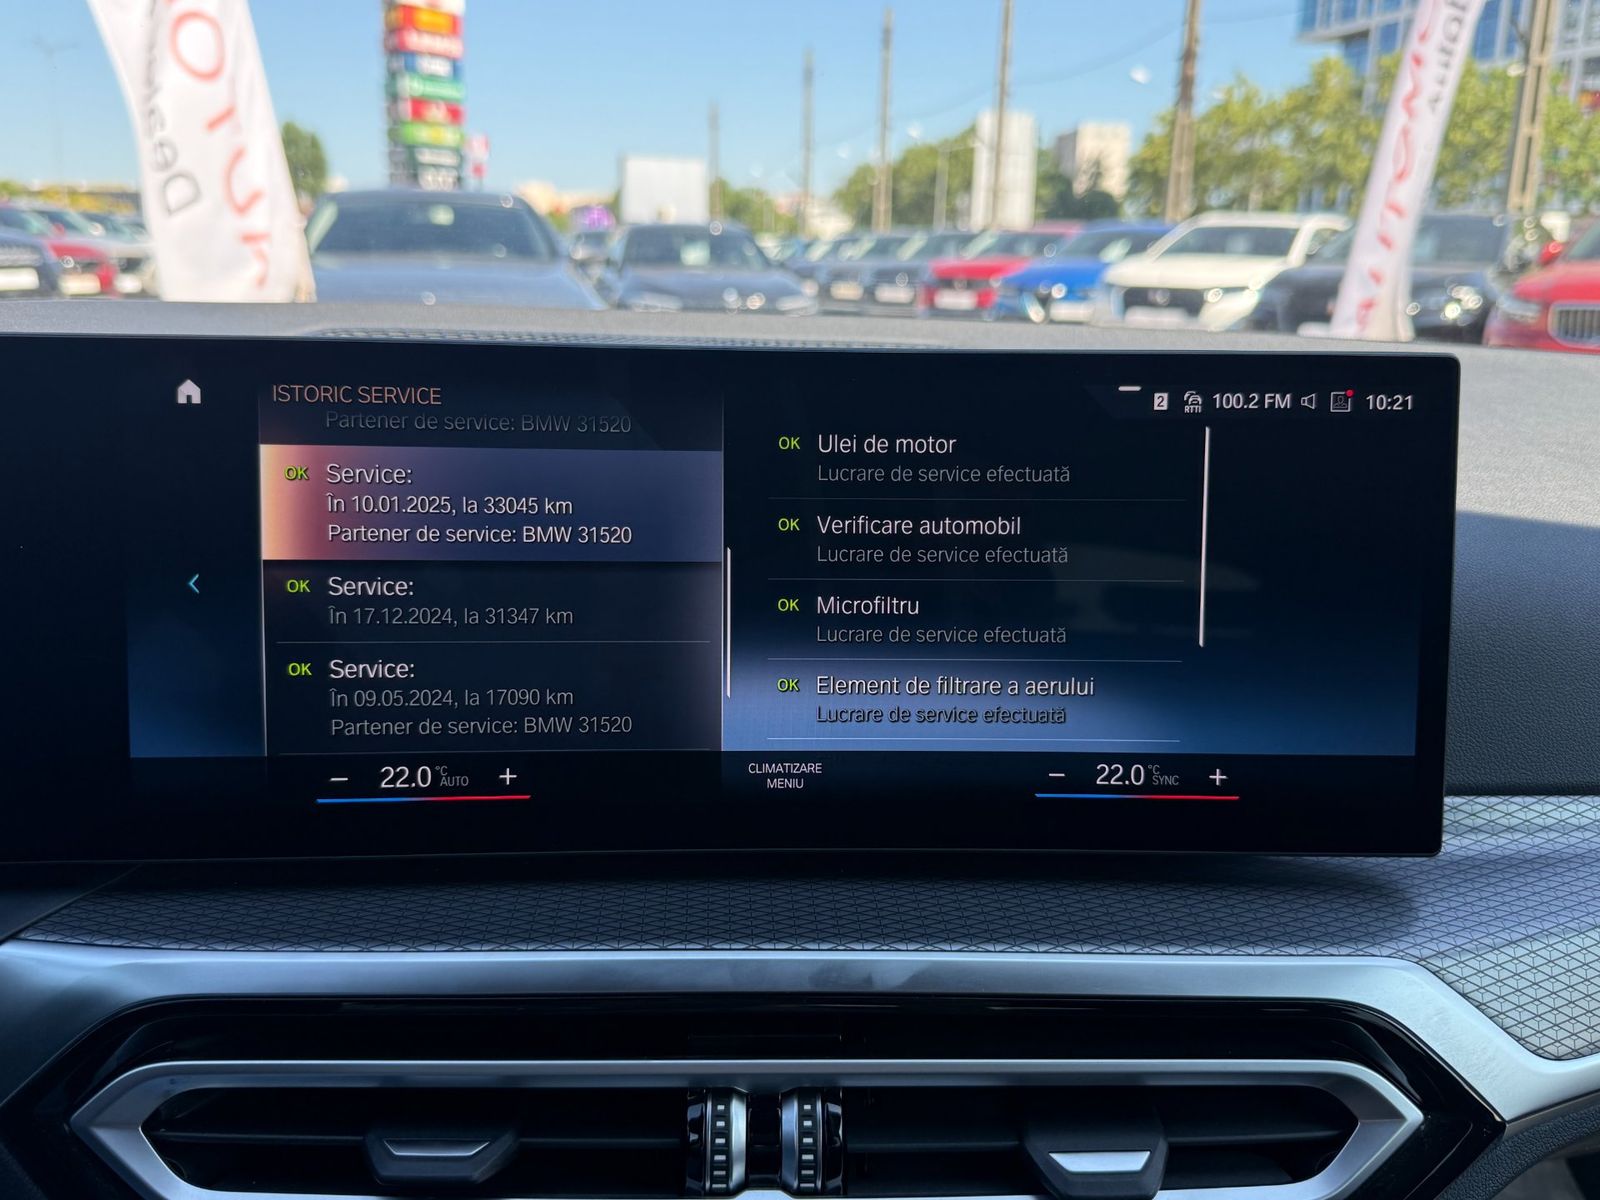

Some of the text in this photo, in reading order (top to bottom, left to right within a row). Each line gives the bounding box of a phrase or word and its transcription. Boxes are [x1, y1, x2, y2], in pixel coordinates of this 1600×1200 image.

[273, 385, 441, 405] ISTORIC SERVICE
[1157, 395, 1165, 408] 2
[1213, 393, 1291, 409] 100.2 FM
[1366, 395, 1413, 410] 10:21
[325, 410, 632, 433] Partener de service: BMW 31520
[778, 436, 800, 450] OK
[817, 434, 957, 454] Ulei de motor
[284, 466, 308, 480] OK
[327, 463, 413, 484] Service:
[817, 465, 1070, 483] Lucrare de service efectuată
[327, 493, 573, 516] În 10.01.2025, la 33045 km
[328, 524, 632, 544] Partener de service: BMW 31520
[778, 518, 800, 531] OK
[817, 516, 1021, 535] Verificare automobil
[817, 546, 1069, 564] Lucrare de service efectuată
[286, 579, 310, 594] OK
[328, 577, 414, 598] Service:
[777, 599, 799, 612] OK
[817, 596, 919, 616] Microfiltru
[329, 605, 574, 627] În 17.12.2024, la 31347 km
[816, 626, 1067, 645] Lucrare de service efectuată
[288, 662, 312, 676] OK
[329, 659, 415, 680] Service:
[777, 678, 799, 692] OK
[817, 676, 1094, 697] Element de filtrare a aerului
[330, 687, 574, 710] În 09.05.2024, la 17090 km
[816, 705, 1066, 724] Lucrare de service efectuată
[331, 716, 633, 737] Partener de service: BMW 31520
[380, 766, 431, 789] 22.0
[748, 763, 822, 775] CLIMATIZARE
[1096, 763, 1145, 787] 22.0
[440, 775, 469, 787] AUTO
[767, 778, 804, 790] MENIU
[1152, 775, 1179, 787] SYNC
